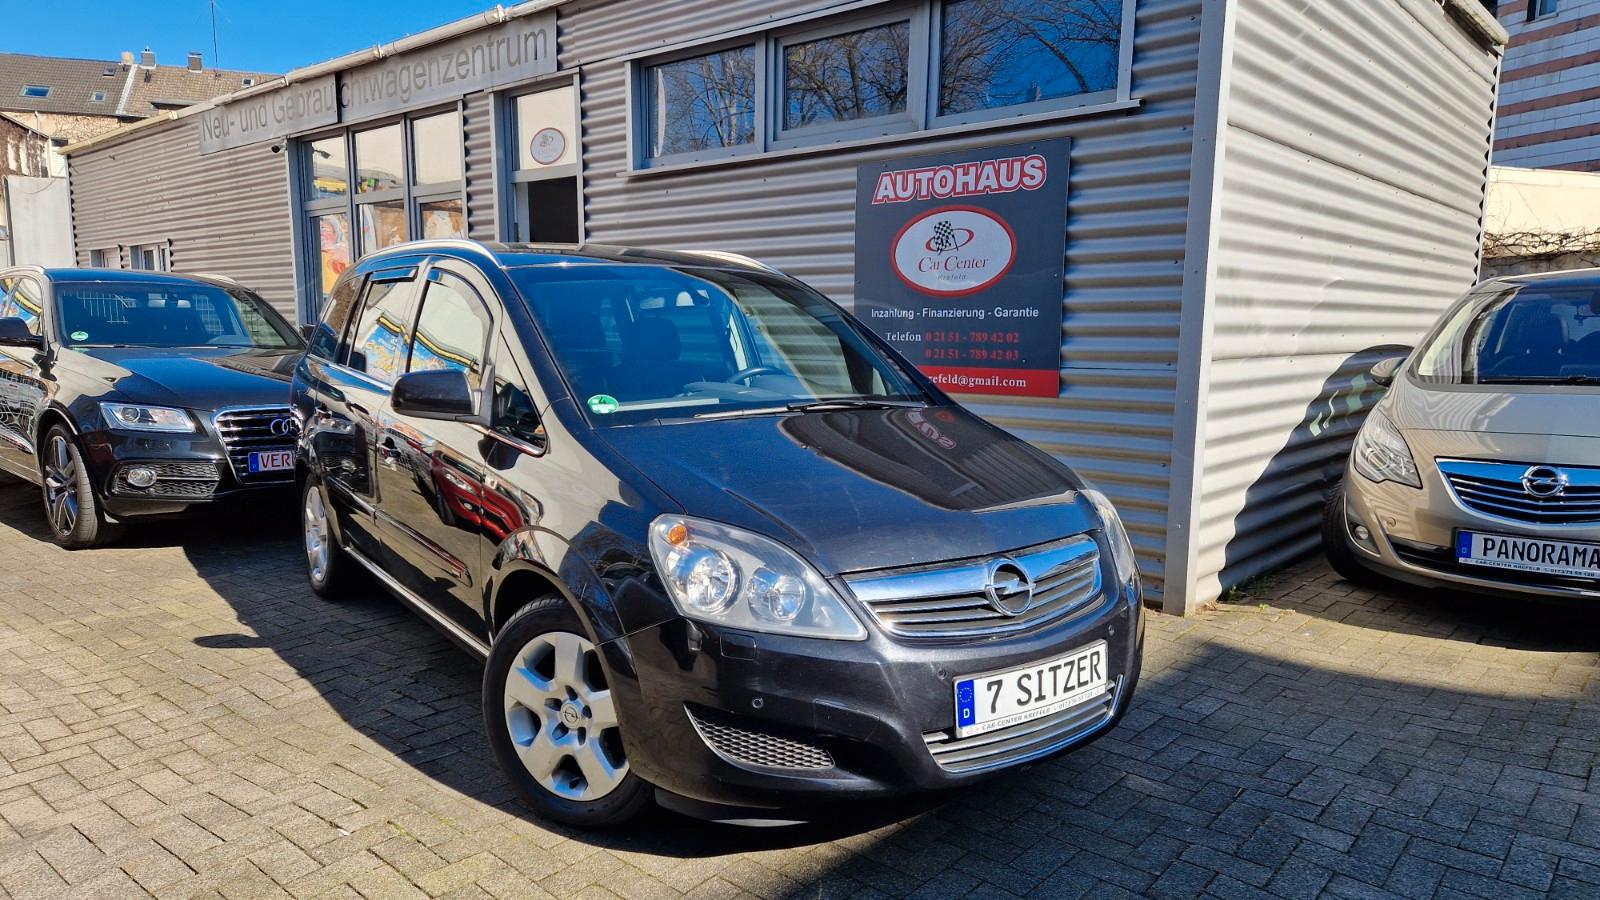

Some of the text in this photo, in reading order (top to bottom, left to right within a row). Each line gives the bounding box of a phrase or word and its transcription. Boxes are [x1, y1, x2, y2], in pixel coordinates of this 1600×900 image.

[202, 113, 235, 142] Neu-
[240, 96, 268, 132] und
[873, 155, 1047, 204] AUTOHAUS
[918, 255, 988, 272] Car Center
[871, 308, 914, 319] Inzahlung
[922, 307, 985, 319] Finanzierung
[994, 306, 1039, 318] Garantie
[886, 332, 921, 342] Telefon
[260, 453, 296, 469] VER
[1483, 537, 1600, 569] PANORAMA
[986, 650, 1102, 714] 7 SITZER
[963, 708, 971, 719] D
